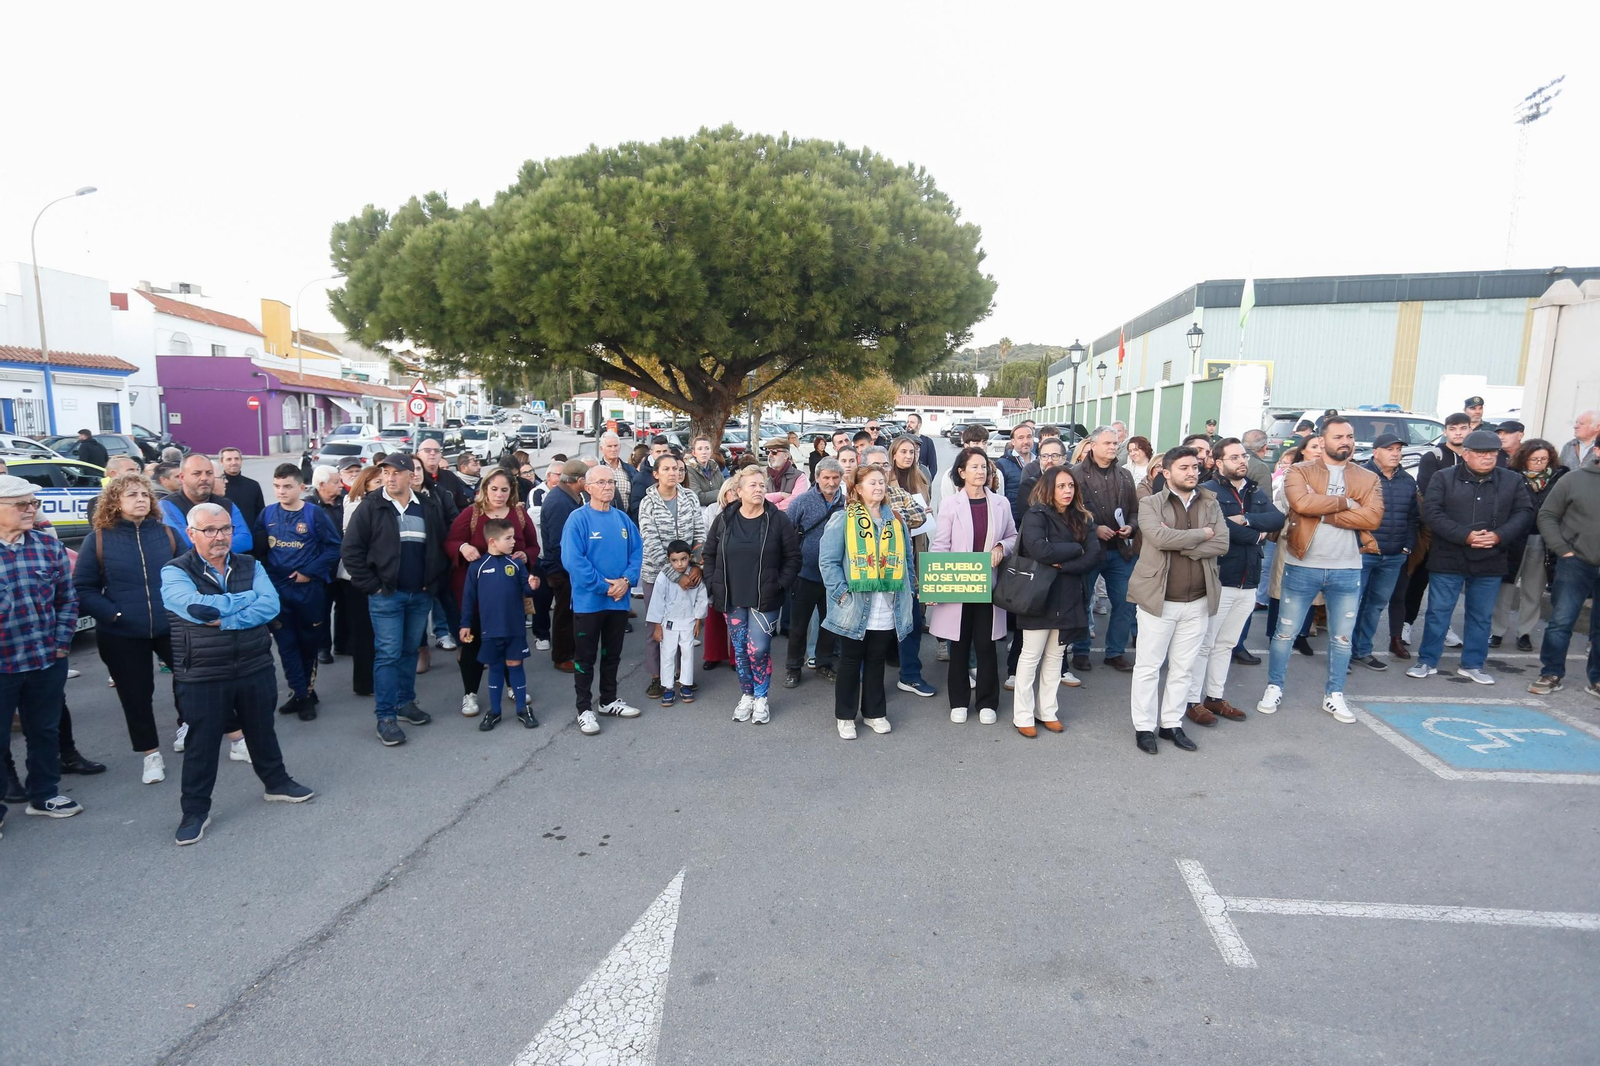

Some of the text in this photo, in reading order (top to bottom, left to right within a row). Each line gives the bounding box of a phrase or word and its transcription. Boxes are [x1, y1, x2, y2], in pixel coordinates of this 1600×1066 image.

[413, 402, 423, 411] 10
[42, 500, 89, 513] OLIC
[276, 539, 305, 550] Spotify
[944, 562, 983, 571] PUEBLO
[924, 573, 987, 582] NO SE VENDE
[922, 584, 935, 593] SE
